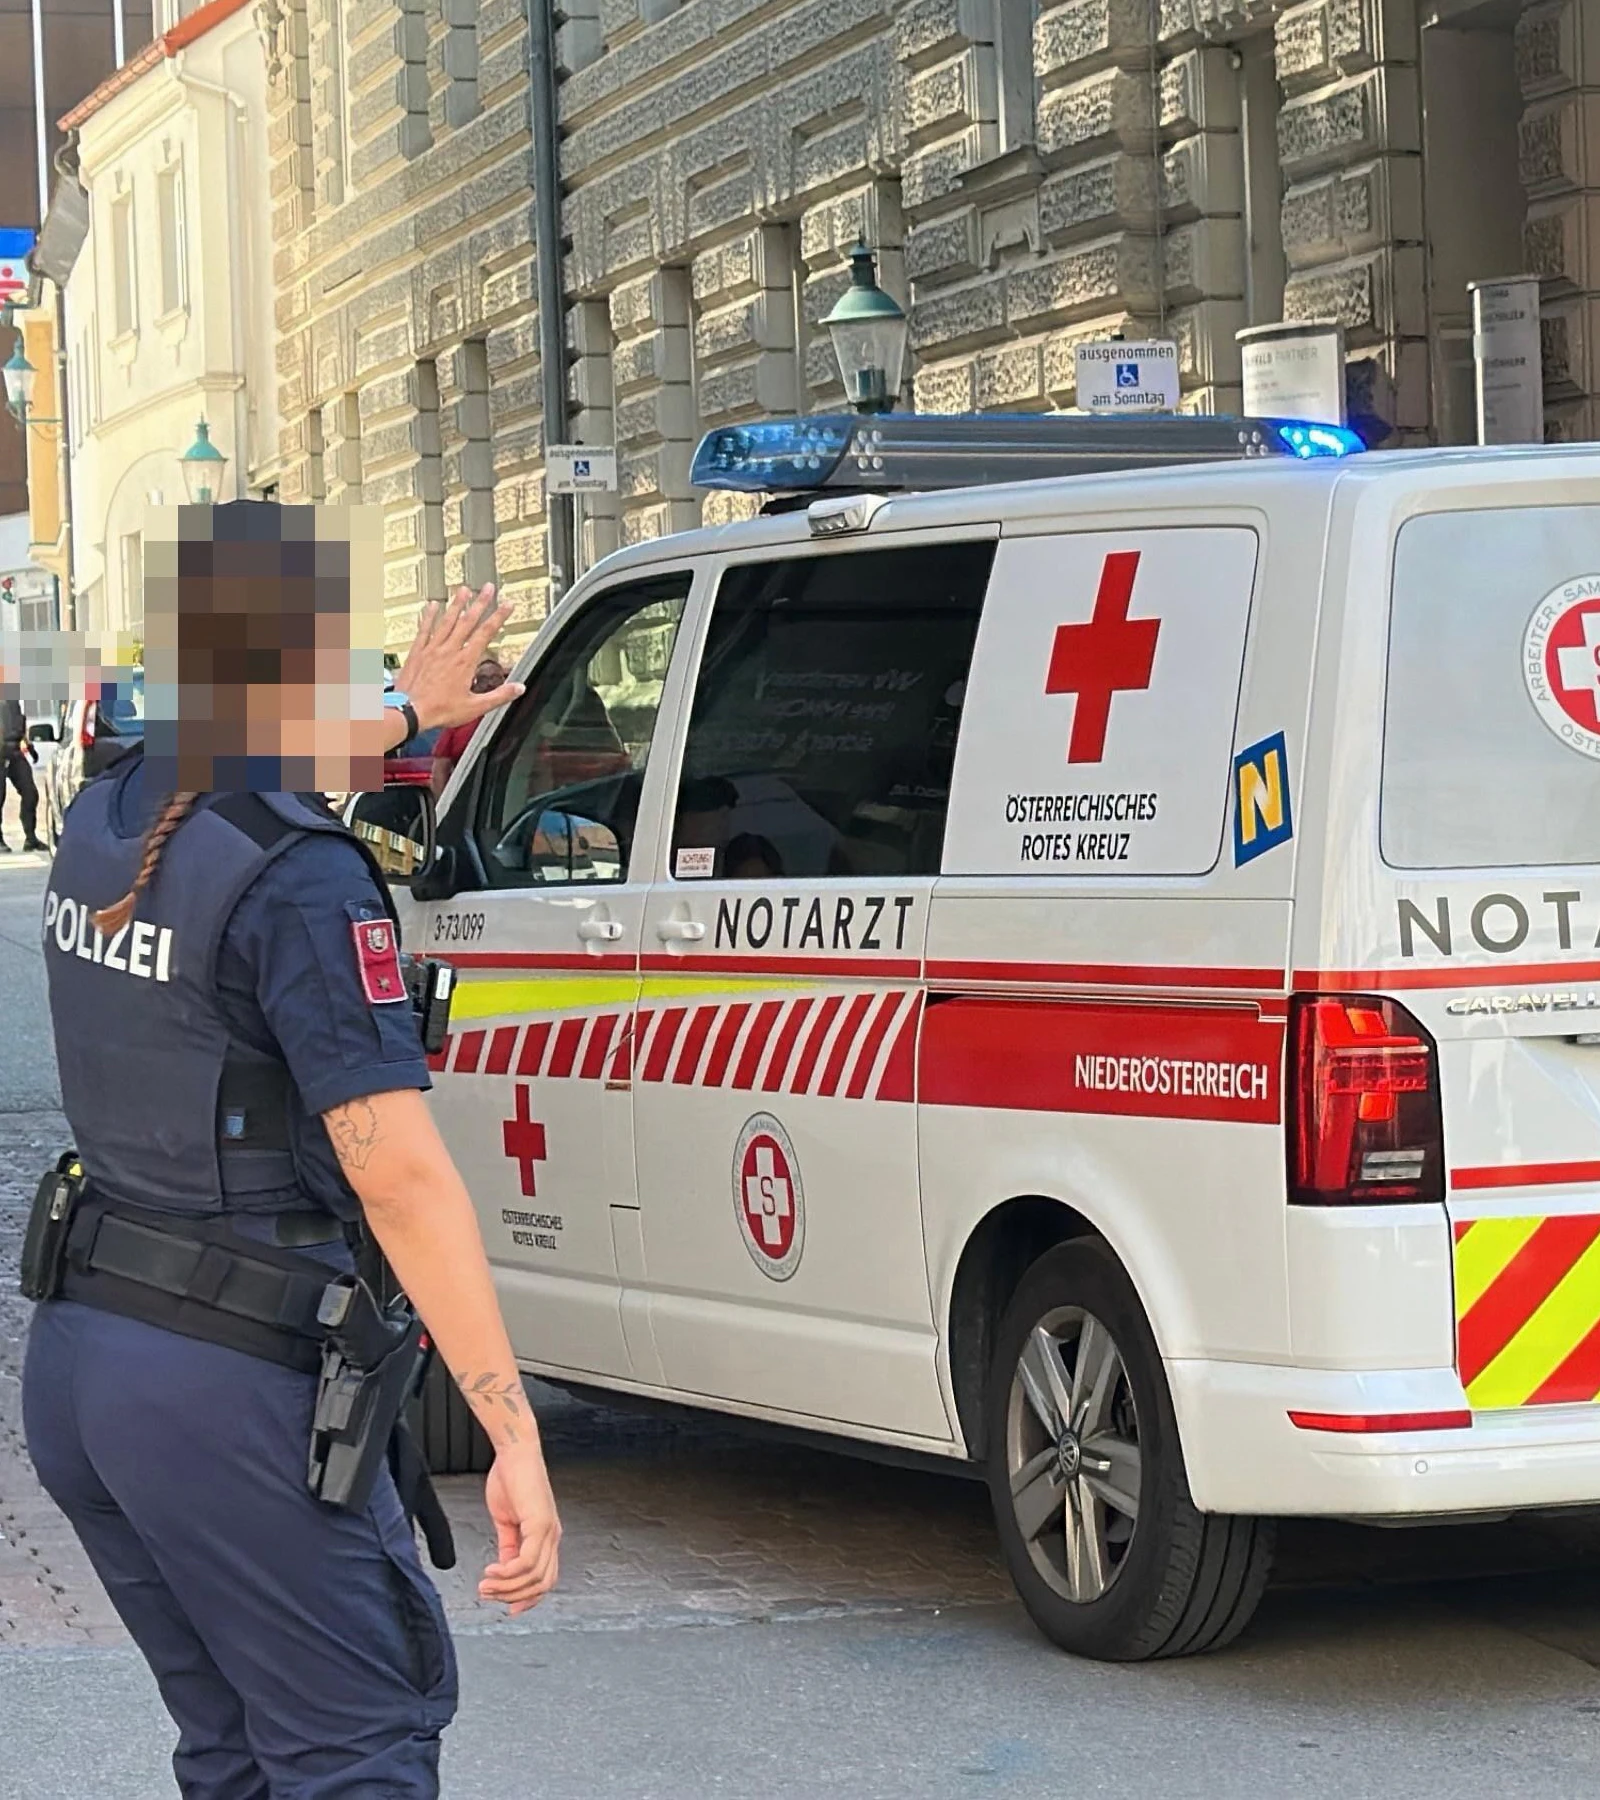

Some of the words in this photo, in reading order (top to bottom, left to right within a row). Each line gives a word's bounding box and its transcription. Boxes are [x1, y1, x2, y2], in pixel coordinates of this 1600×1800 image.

[1079, 346, 1174, 362] ausgenommen
[1092, 394, 1111, 406] am
[1114, 391, 1166, 406] Sonntag
[1528, 606, 1556, 702] ARBEITER
[1005, 793, 1158, 823] ÖSTERREICHISCHES
[1239, 748, 1284, 846] N
[1020, 833, 1072, 861] ROTES
[1075, 833, 1131, 860] KREUZ
[434, 913, 486, 941] 3-73/099
[715, 897, 914, 950] NOTARZT
[1074, 1054, 1268, 1101] NIEDERÖSTERREICH
[760, 1175, 776, 1217] S
